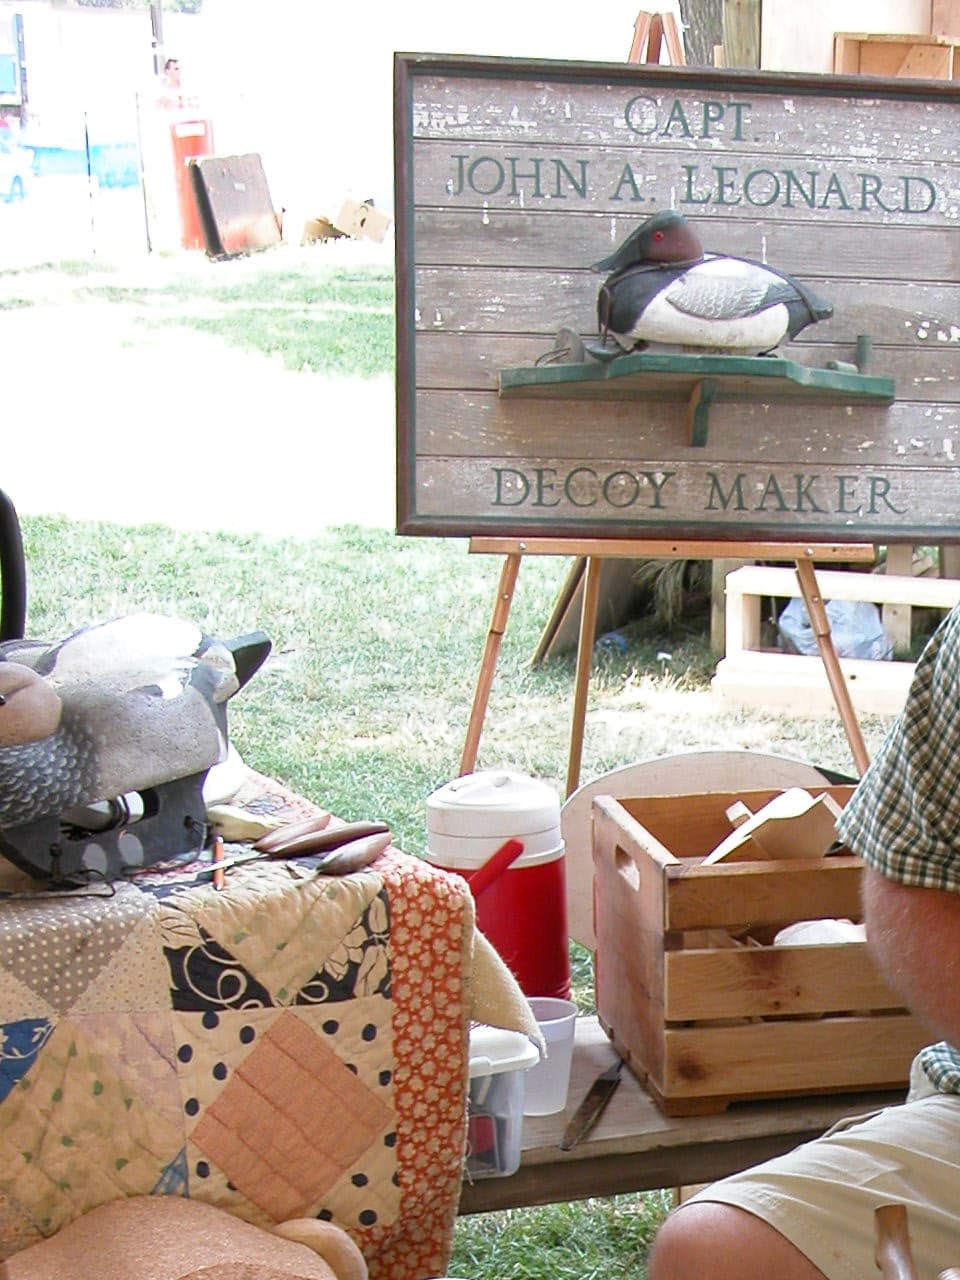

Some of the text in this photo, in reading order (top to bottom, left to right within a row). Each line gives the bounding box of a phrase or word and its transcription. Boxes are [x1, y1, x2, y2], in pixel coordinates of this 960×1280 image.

[624, 95, 760, 142] CAPT.
[445, 154, 937, 214] JOHN A. LEONARD
[491, 466, 910, 516] DECOY MAKER
